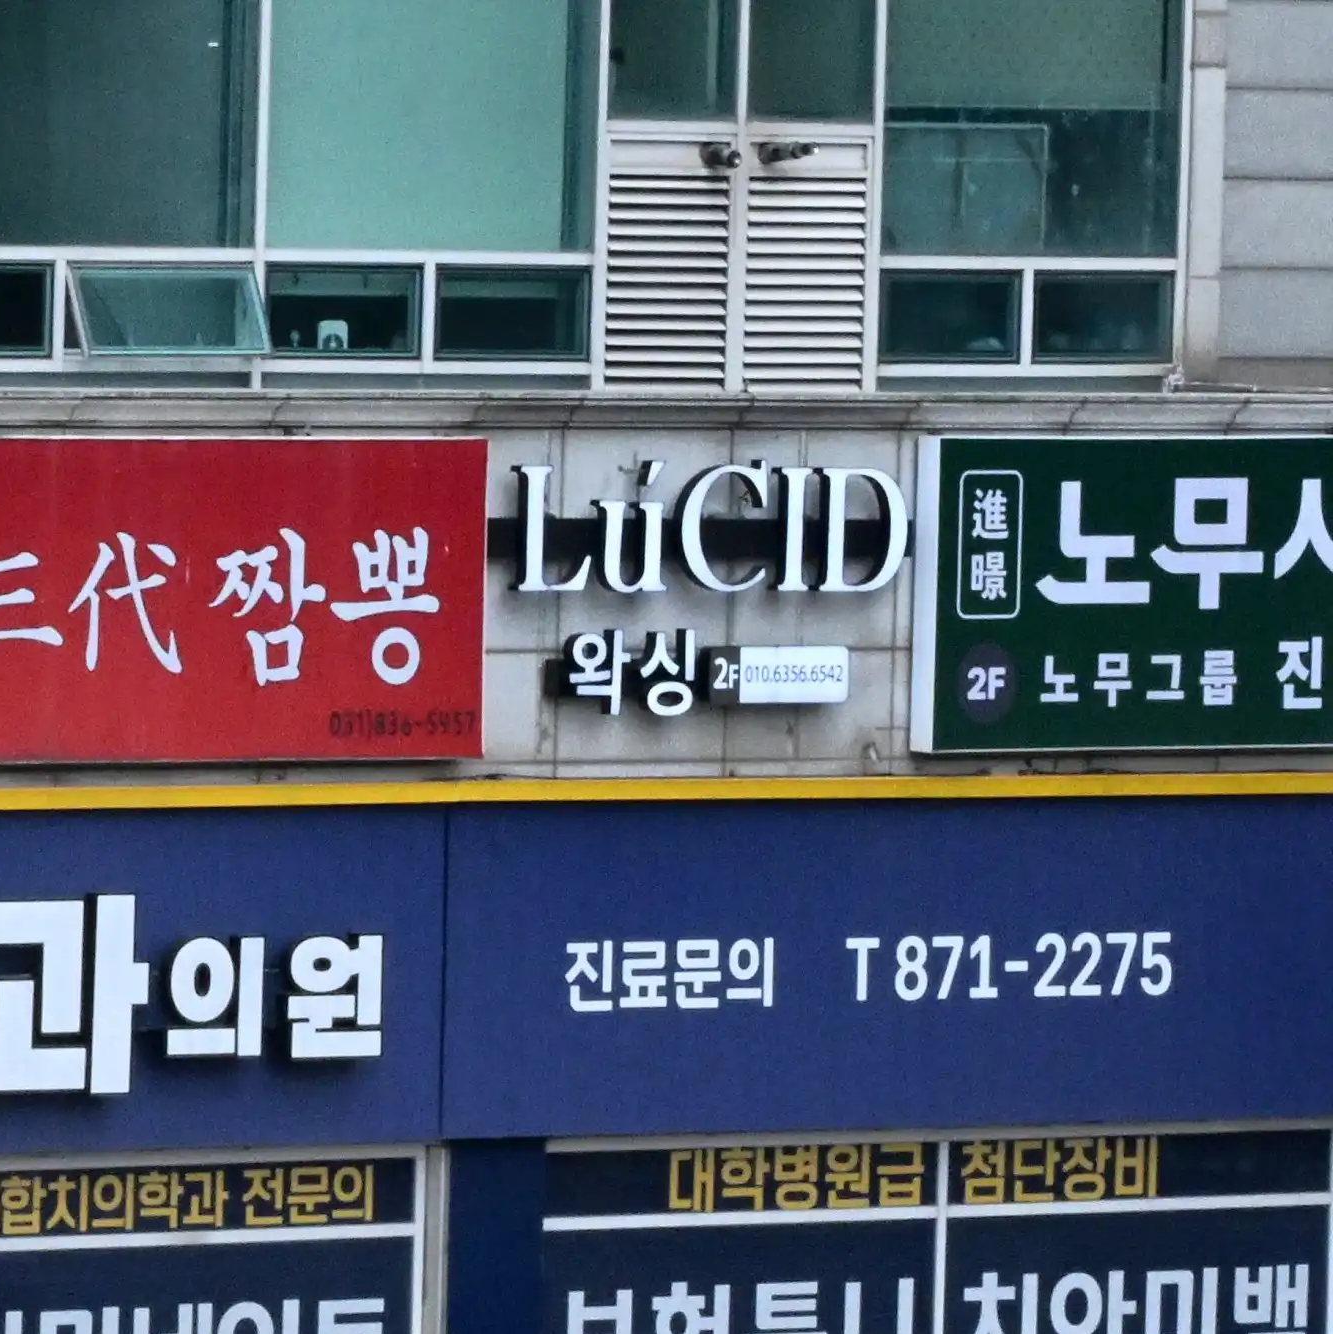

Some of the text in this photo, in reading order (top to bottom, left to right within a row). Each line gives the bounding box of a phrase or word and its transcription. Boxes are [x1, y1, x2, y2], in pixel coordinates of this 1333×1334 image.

[207, 525, 441, 687] 짬뽕
[568, 629, 844, 717] 왁싱 2F 010.6356.6542
[966, 667, 1008, 701] 2F
[1039, 649, 1238, 708] 노무그룹
[564, 936, 776, 1013] 진료문의
[894, 930, 1173, 1002] 871-2275
[240, 1163, 376, 1228] 전문의
[668, 1135, 1160, 1214] 대학병원급 첨단장비
